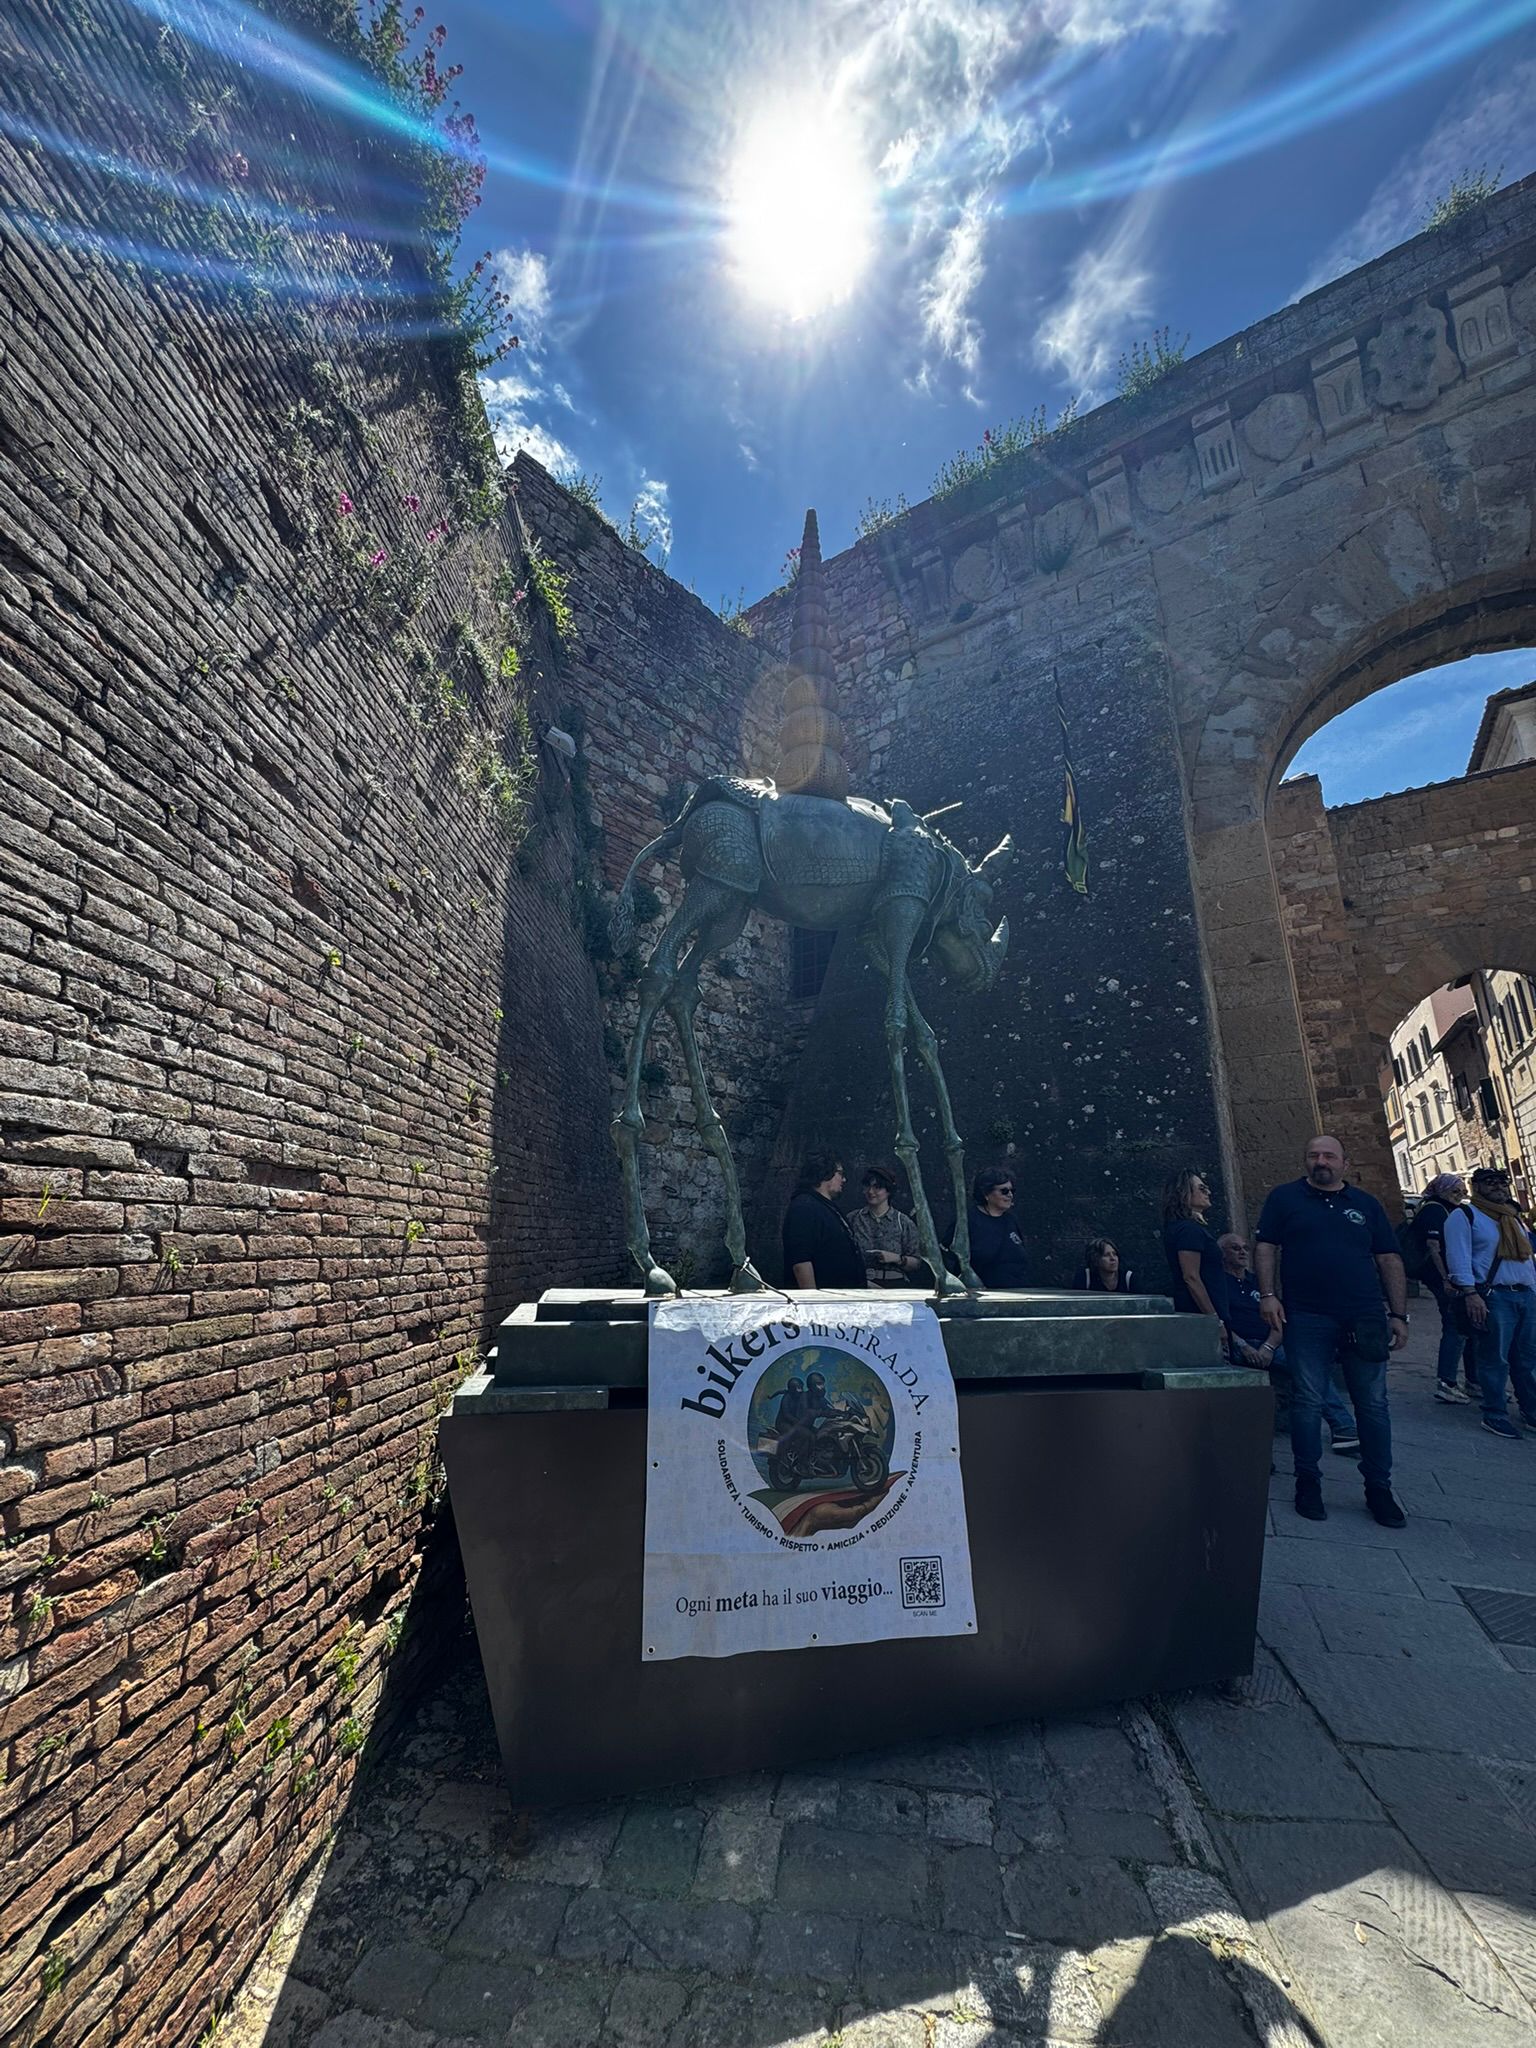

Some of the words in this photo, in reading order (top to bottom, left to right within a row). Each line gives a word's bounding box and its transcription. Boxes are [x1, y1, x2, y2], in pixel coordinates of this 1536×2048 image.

[681, 1317, 801, 1419] bikers
[811, 1321, 830, 1337] in
[834, 1321, 930, 1416] S.T.R.A.D.A.
[717, 1439, 741, 1502] SOLIDARIETÀ
[740, 1506, 773, 1539] TURISMO
[779, 1537, 819, 1552] RISPETTO
[827, 1532, 865, 1551] AMICIZIA
[870, 1493, 908, 1533] DEDIZIONE
[907, 1430, 922, 1488] AVVENTURA
[676, 1596, 711, 1617] Ogni
[715, 1590, 758, 1612] meta
[762, 1589, 779, 1607] ha
[783, 1587, 791, 1605] il
[795, 1591, 818, 1603] suo
[821, 1578, 893, 1604] viaggio...
